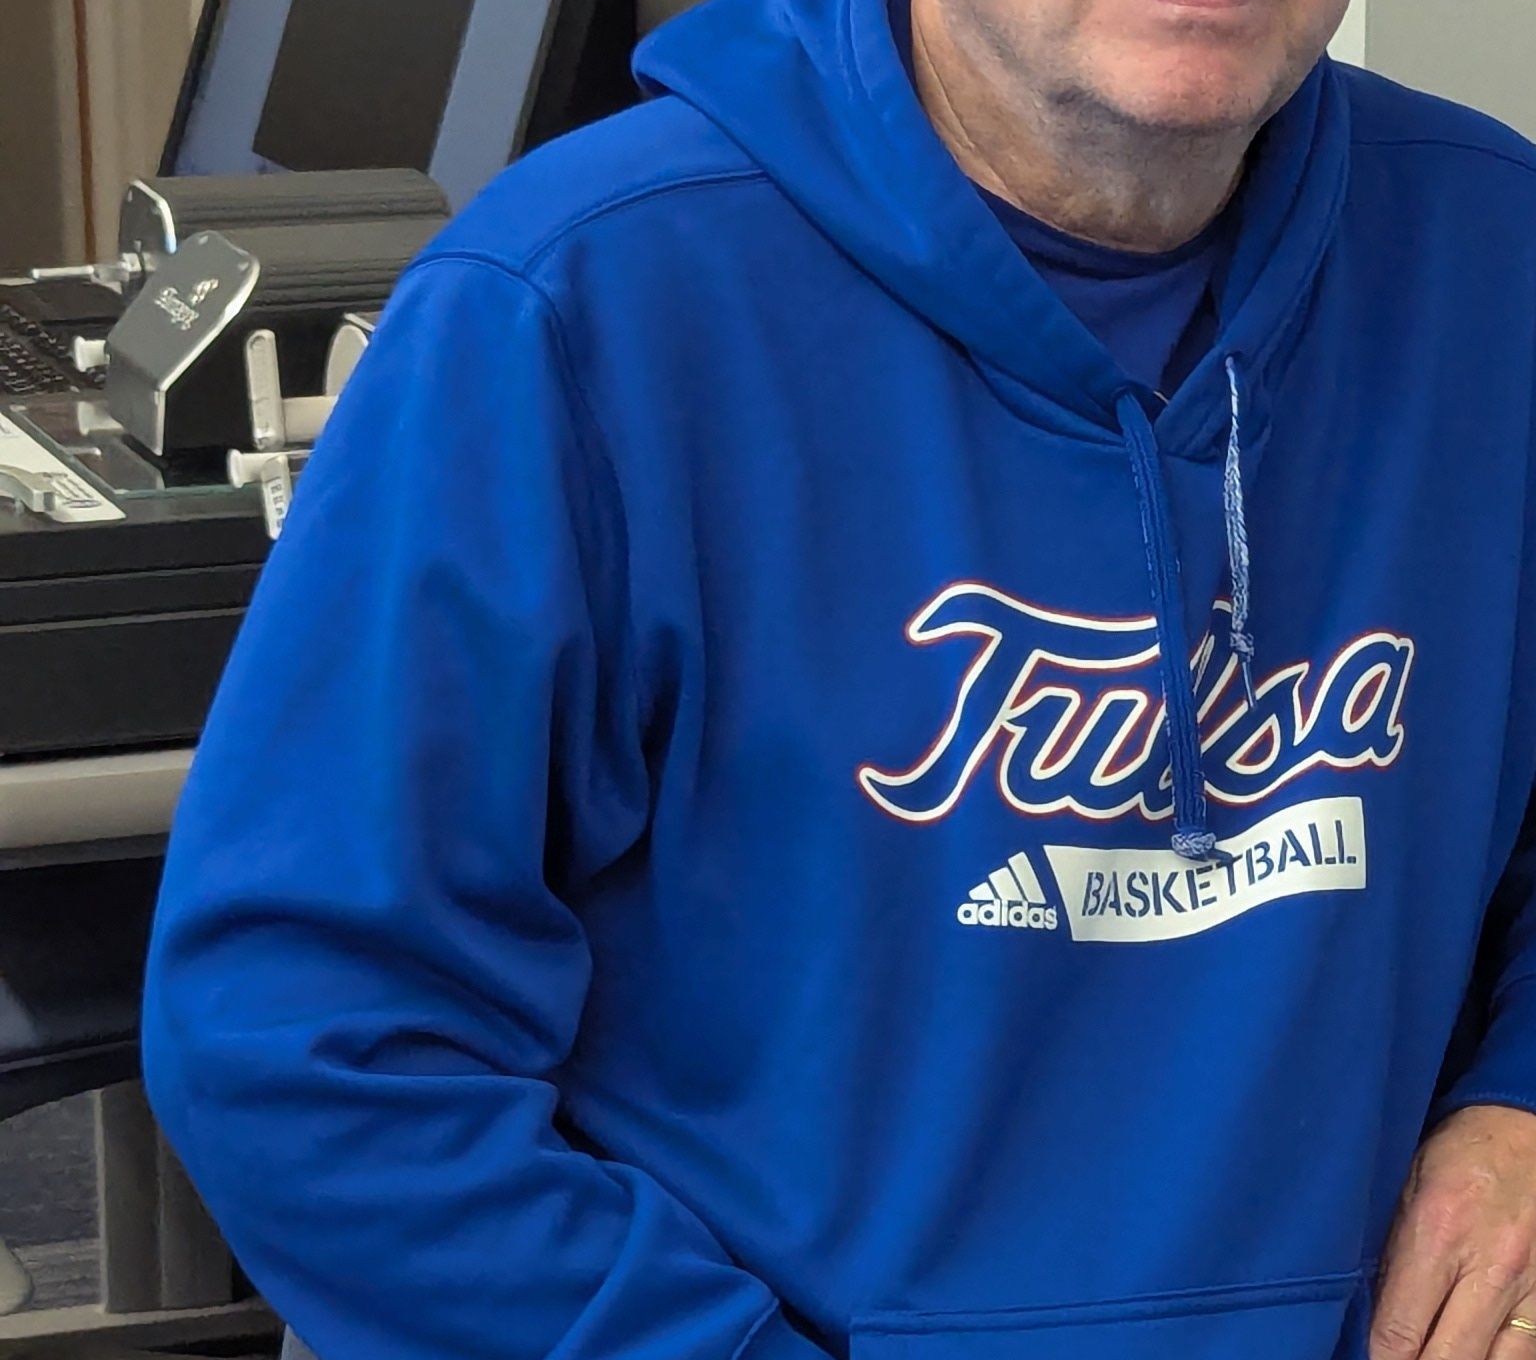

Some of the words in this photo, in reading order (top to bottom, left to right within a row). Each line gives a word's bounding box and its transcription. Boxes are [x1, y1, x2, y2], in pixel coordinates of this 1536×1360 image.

[859, 581, 1414, 823] Tulsa
[957, 898, 1058, 930] adidas
[1082, 820, 1357, 918] BASKETBALL
